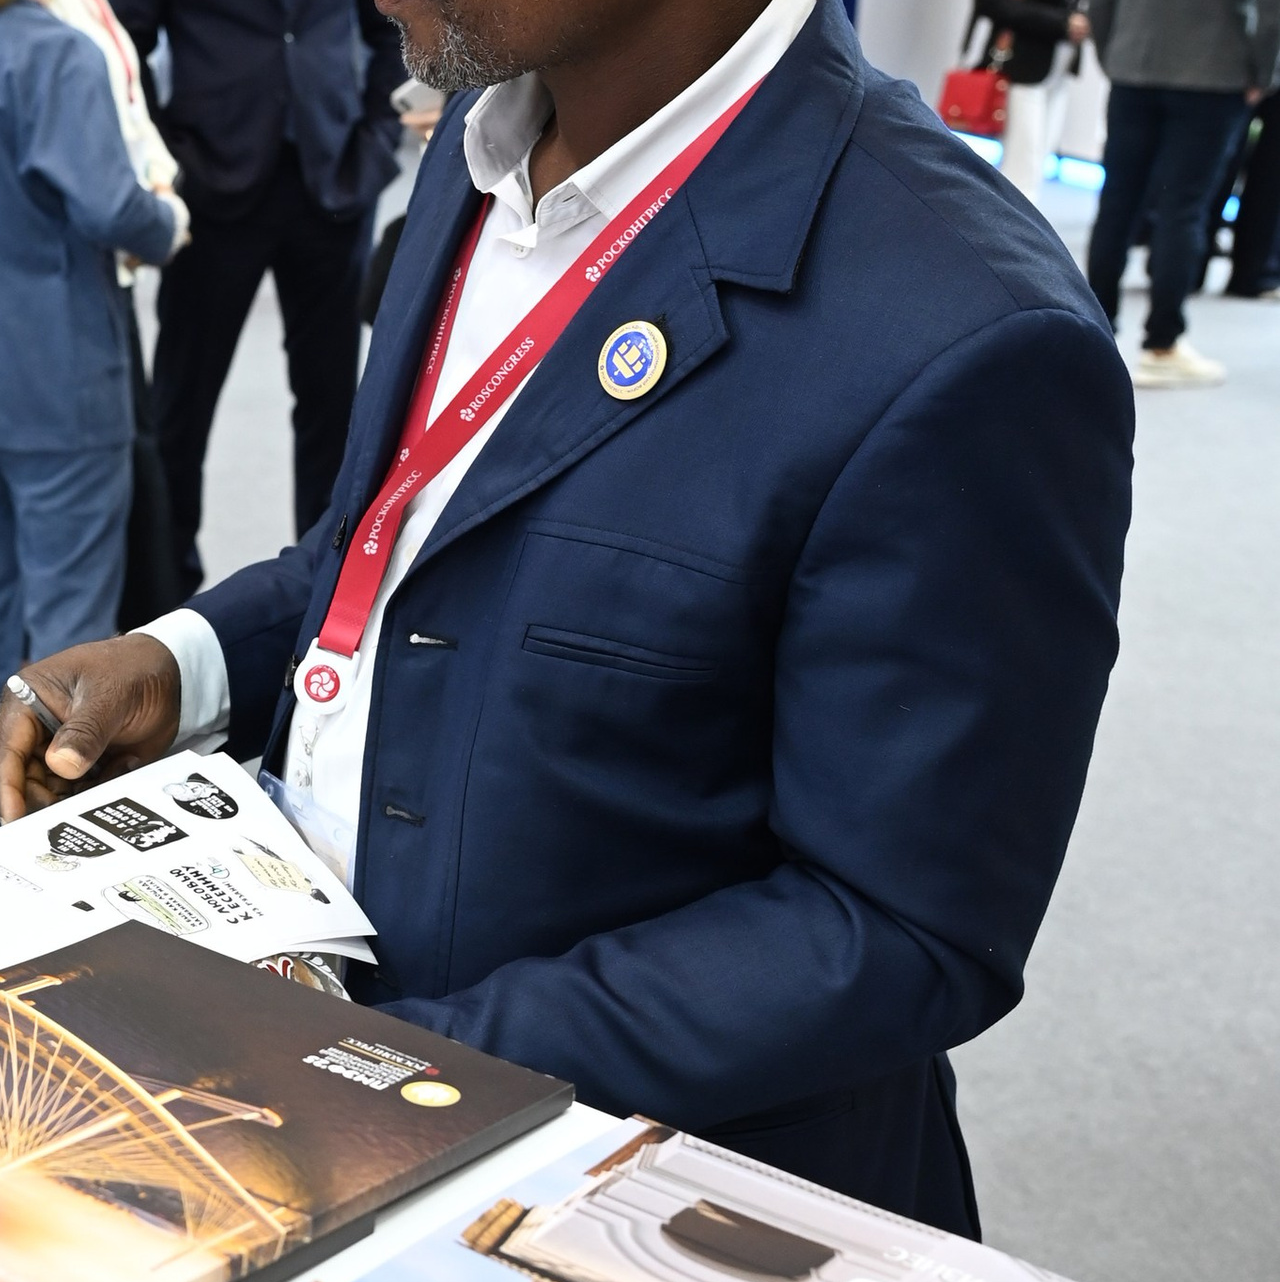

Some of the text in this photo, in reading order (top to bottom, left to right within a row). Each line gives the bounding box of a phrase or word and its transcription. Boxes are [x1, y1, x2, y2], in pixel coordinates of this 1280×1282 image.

[597, 188, 674, 270] РОСКОНГРЕСС
[471, 336, 535, 413] ROSCONGRESS
[369, 470, 422, 540] РОСКОНГРЕСС
[167, 867, 231, 915] ЛЮБОВЬЮ
[180, 862, 241, 909] ЕСЕНИНУ
[224, 916, 241, 925] С
[236, 910, 253, 921] К
